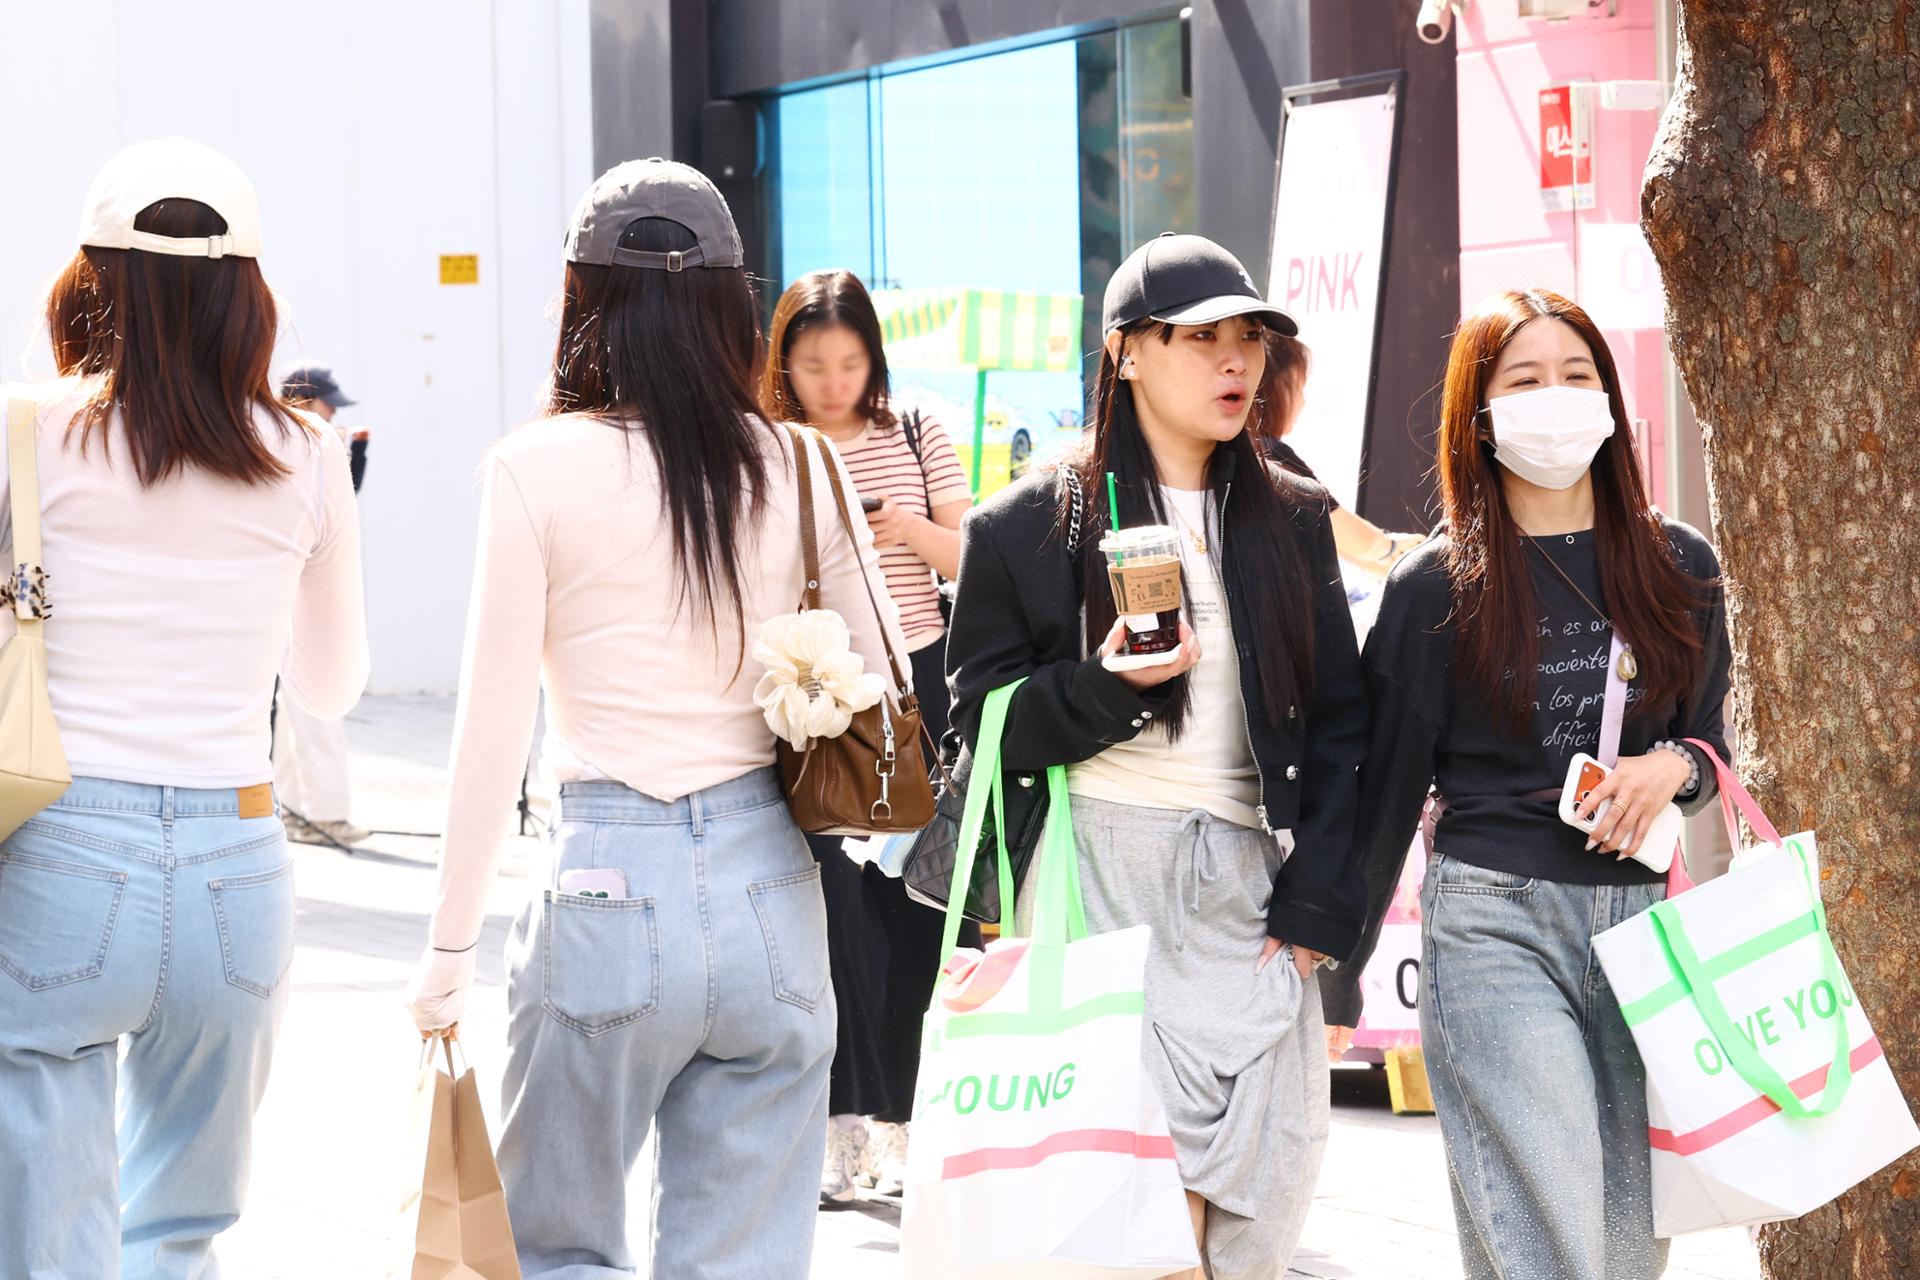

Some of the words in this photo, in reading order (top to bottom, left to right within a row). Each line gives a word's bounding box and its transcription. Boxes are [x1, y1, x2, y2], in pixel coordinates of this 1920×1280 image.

[1285, 251, 1364, 314] PINK
[1563, 621, 1582, 636] es
[1550, 685, 1575, 711] los
